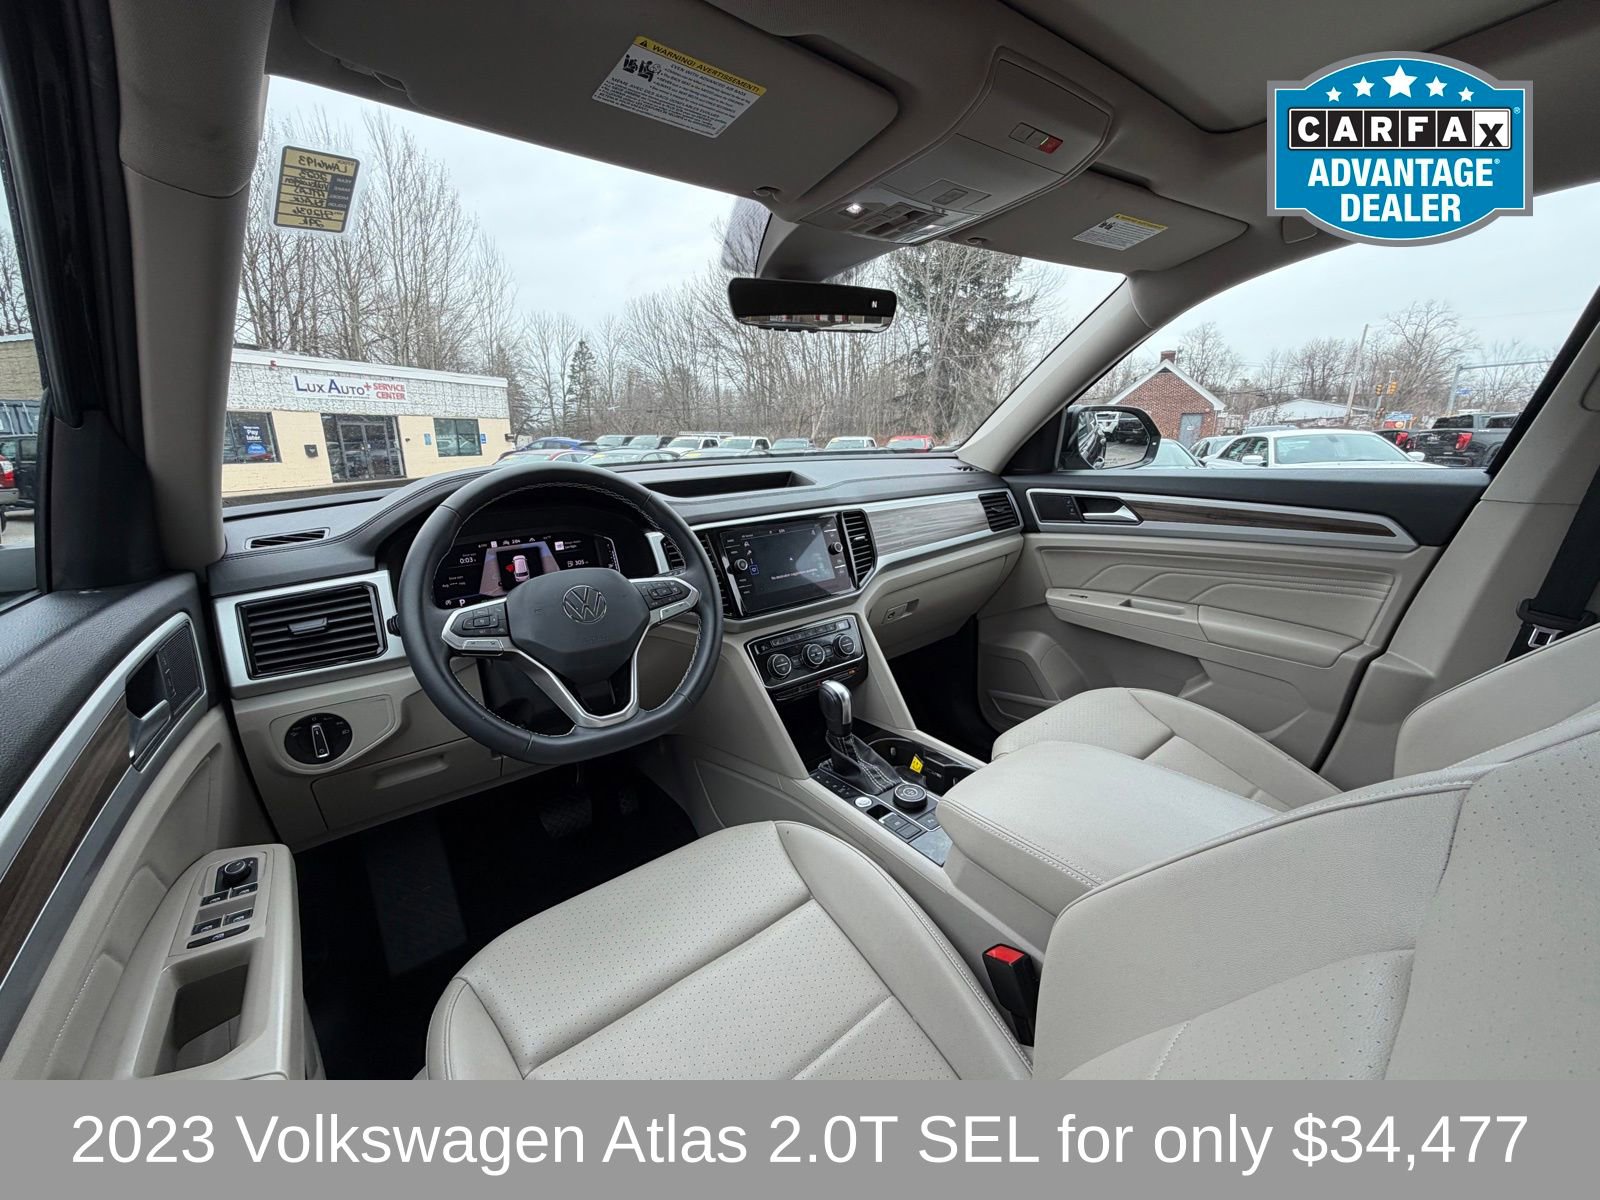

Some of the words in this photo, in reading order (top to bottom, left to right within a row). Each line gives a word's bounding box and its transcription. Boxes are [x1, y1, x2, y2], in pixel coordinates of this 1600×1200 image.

[652, 44, 696, 66] WARNING!
[697, 64, 759, 92] AVERTISSEMENT!
[373, 383, 405, 392] SERVICE
